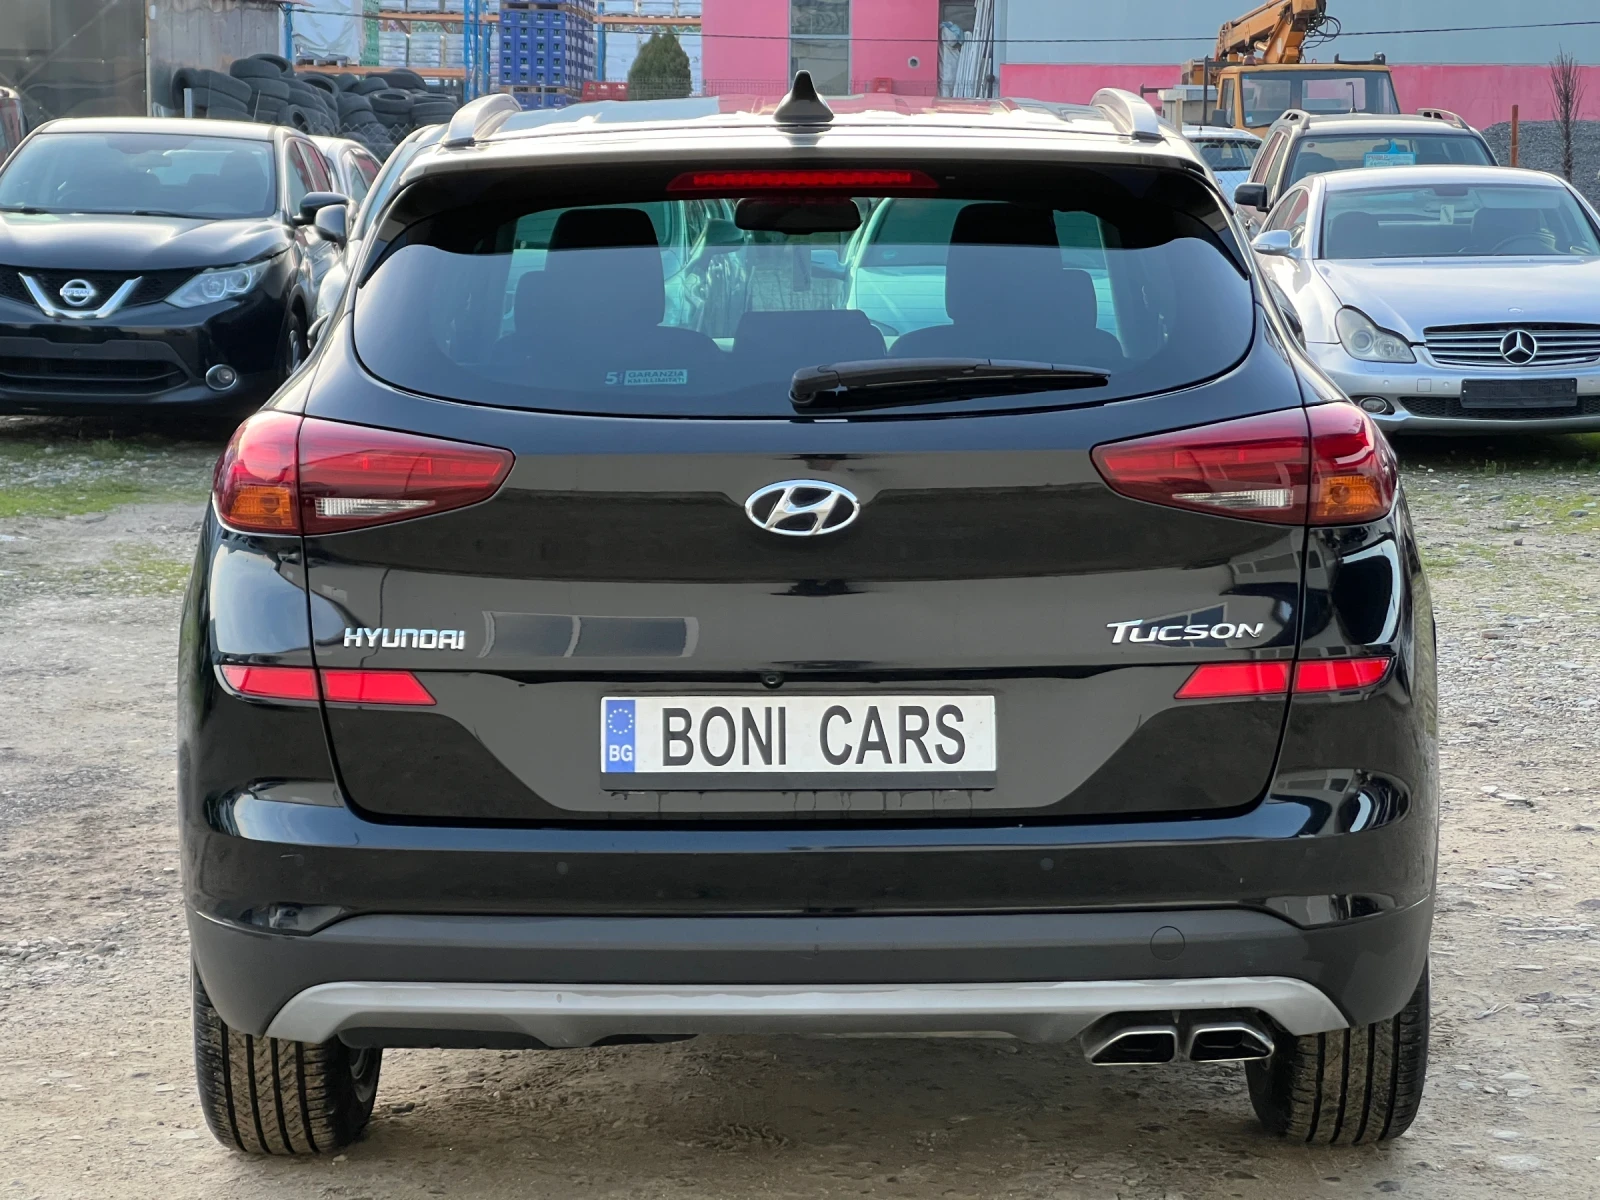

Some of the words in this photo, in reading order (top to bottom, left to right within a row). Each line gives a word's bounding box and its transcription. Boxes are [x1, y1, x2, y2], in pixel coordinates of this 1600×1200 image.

[605, 371, 618, 385] 5
[343, 627, 465, 650] HYUNDAI
[1106, 619, 1264, 644] TUCSON
[662, 706, 787, 767] BONI
[819, 704, 966, 765] CARS
[609, 745, 633, 762] BG
